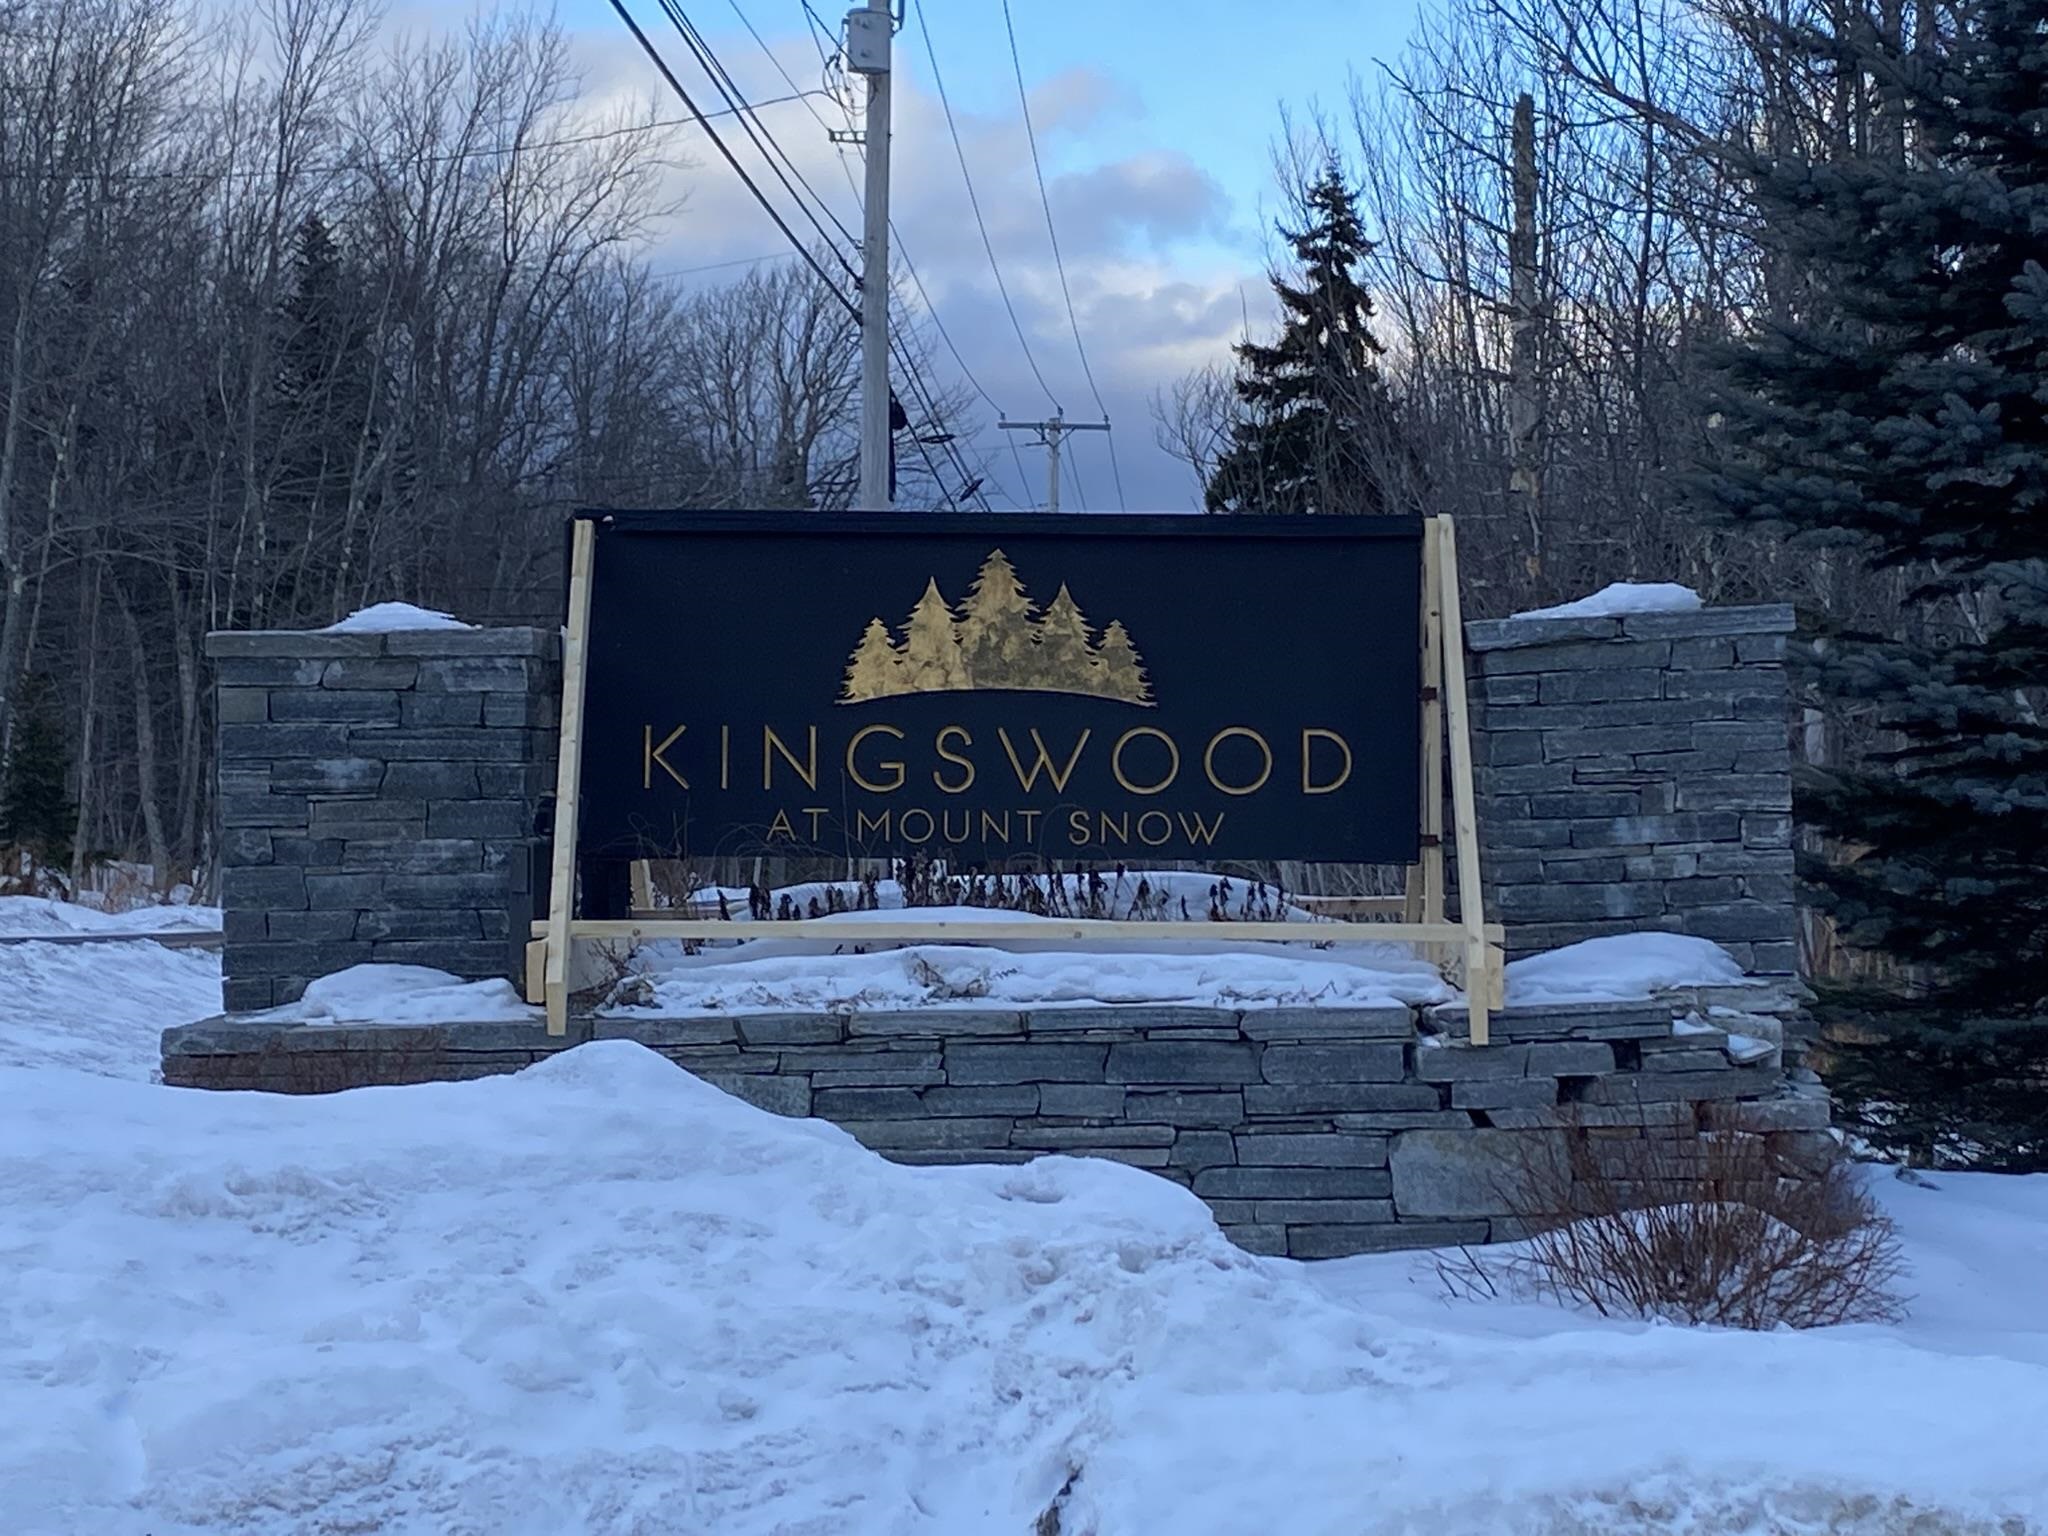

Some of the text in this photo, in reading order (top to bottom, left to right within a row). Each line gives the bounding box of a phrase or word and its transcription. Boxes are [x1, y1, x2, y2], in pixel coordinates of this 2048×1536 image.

[644, 725, 1352, 795] KINGSWOOD
[767, 808, 1225, 846] AT MOUNT SNOW
